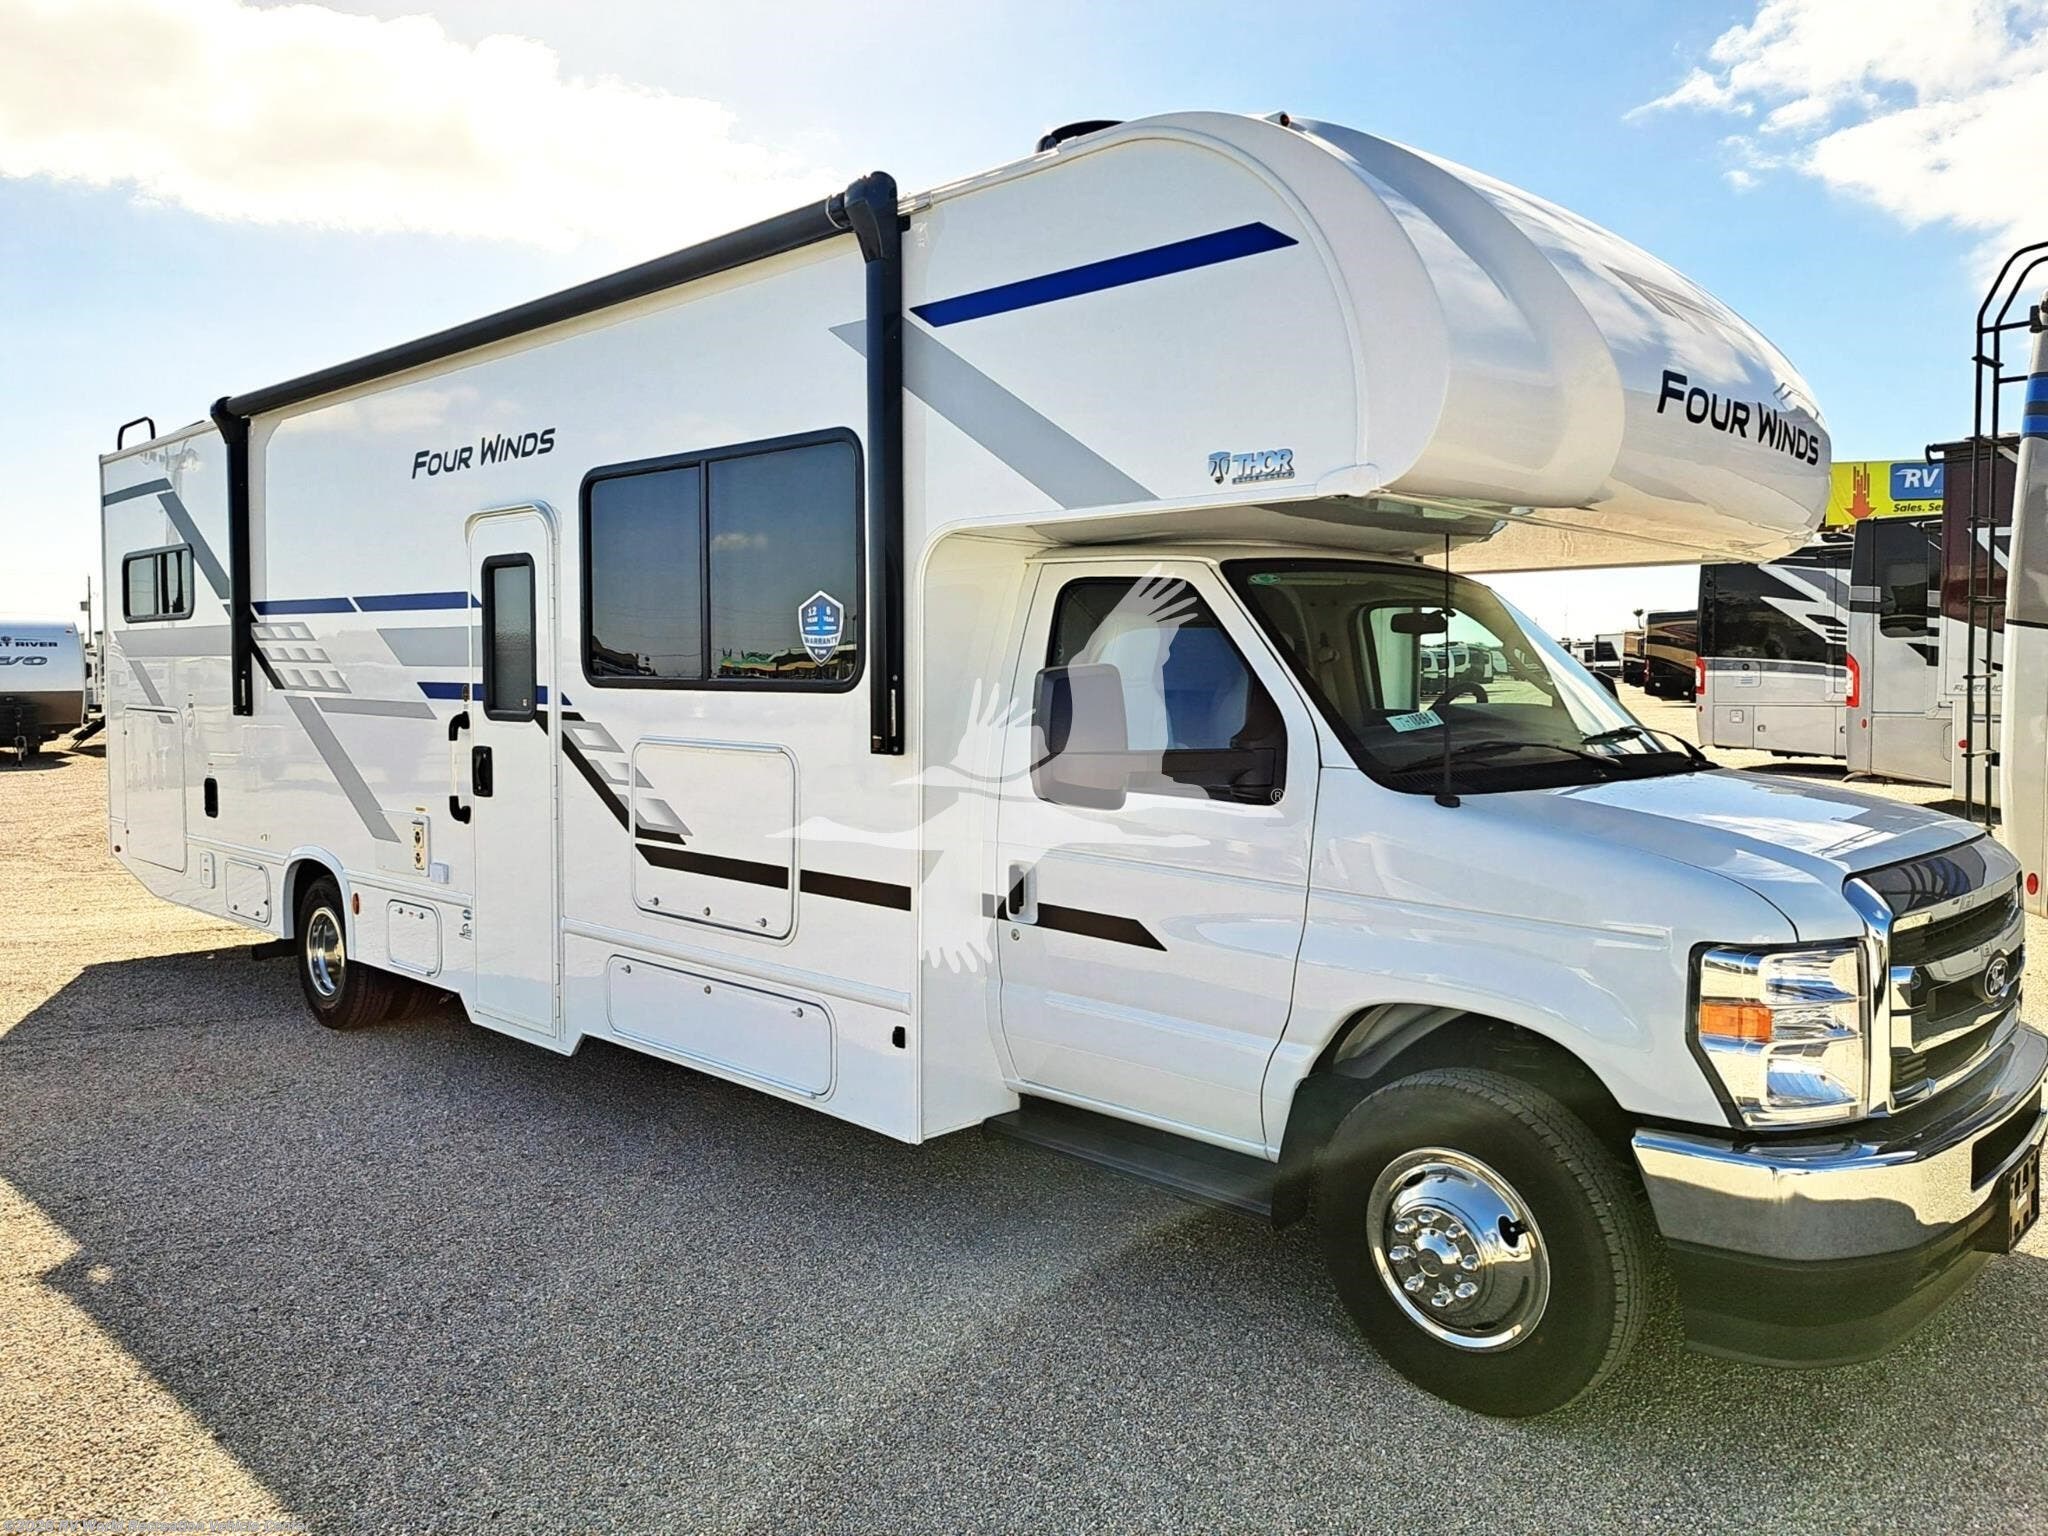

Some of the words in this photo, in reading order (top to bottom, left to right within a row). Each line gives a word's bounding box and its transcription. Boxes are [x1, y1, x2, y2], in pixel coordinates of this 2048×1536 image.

[1656, 369, 1750, 438] FOUR
[1757, 401, 1819, 466] WINDS
[411, 446, 473, 480] FOUR
[480, 427, 556, 466] WINDS
[1231, 448, 1294, 475] THOR
[1895, 468, 1940, 488] RV
